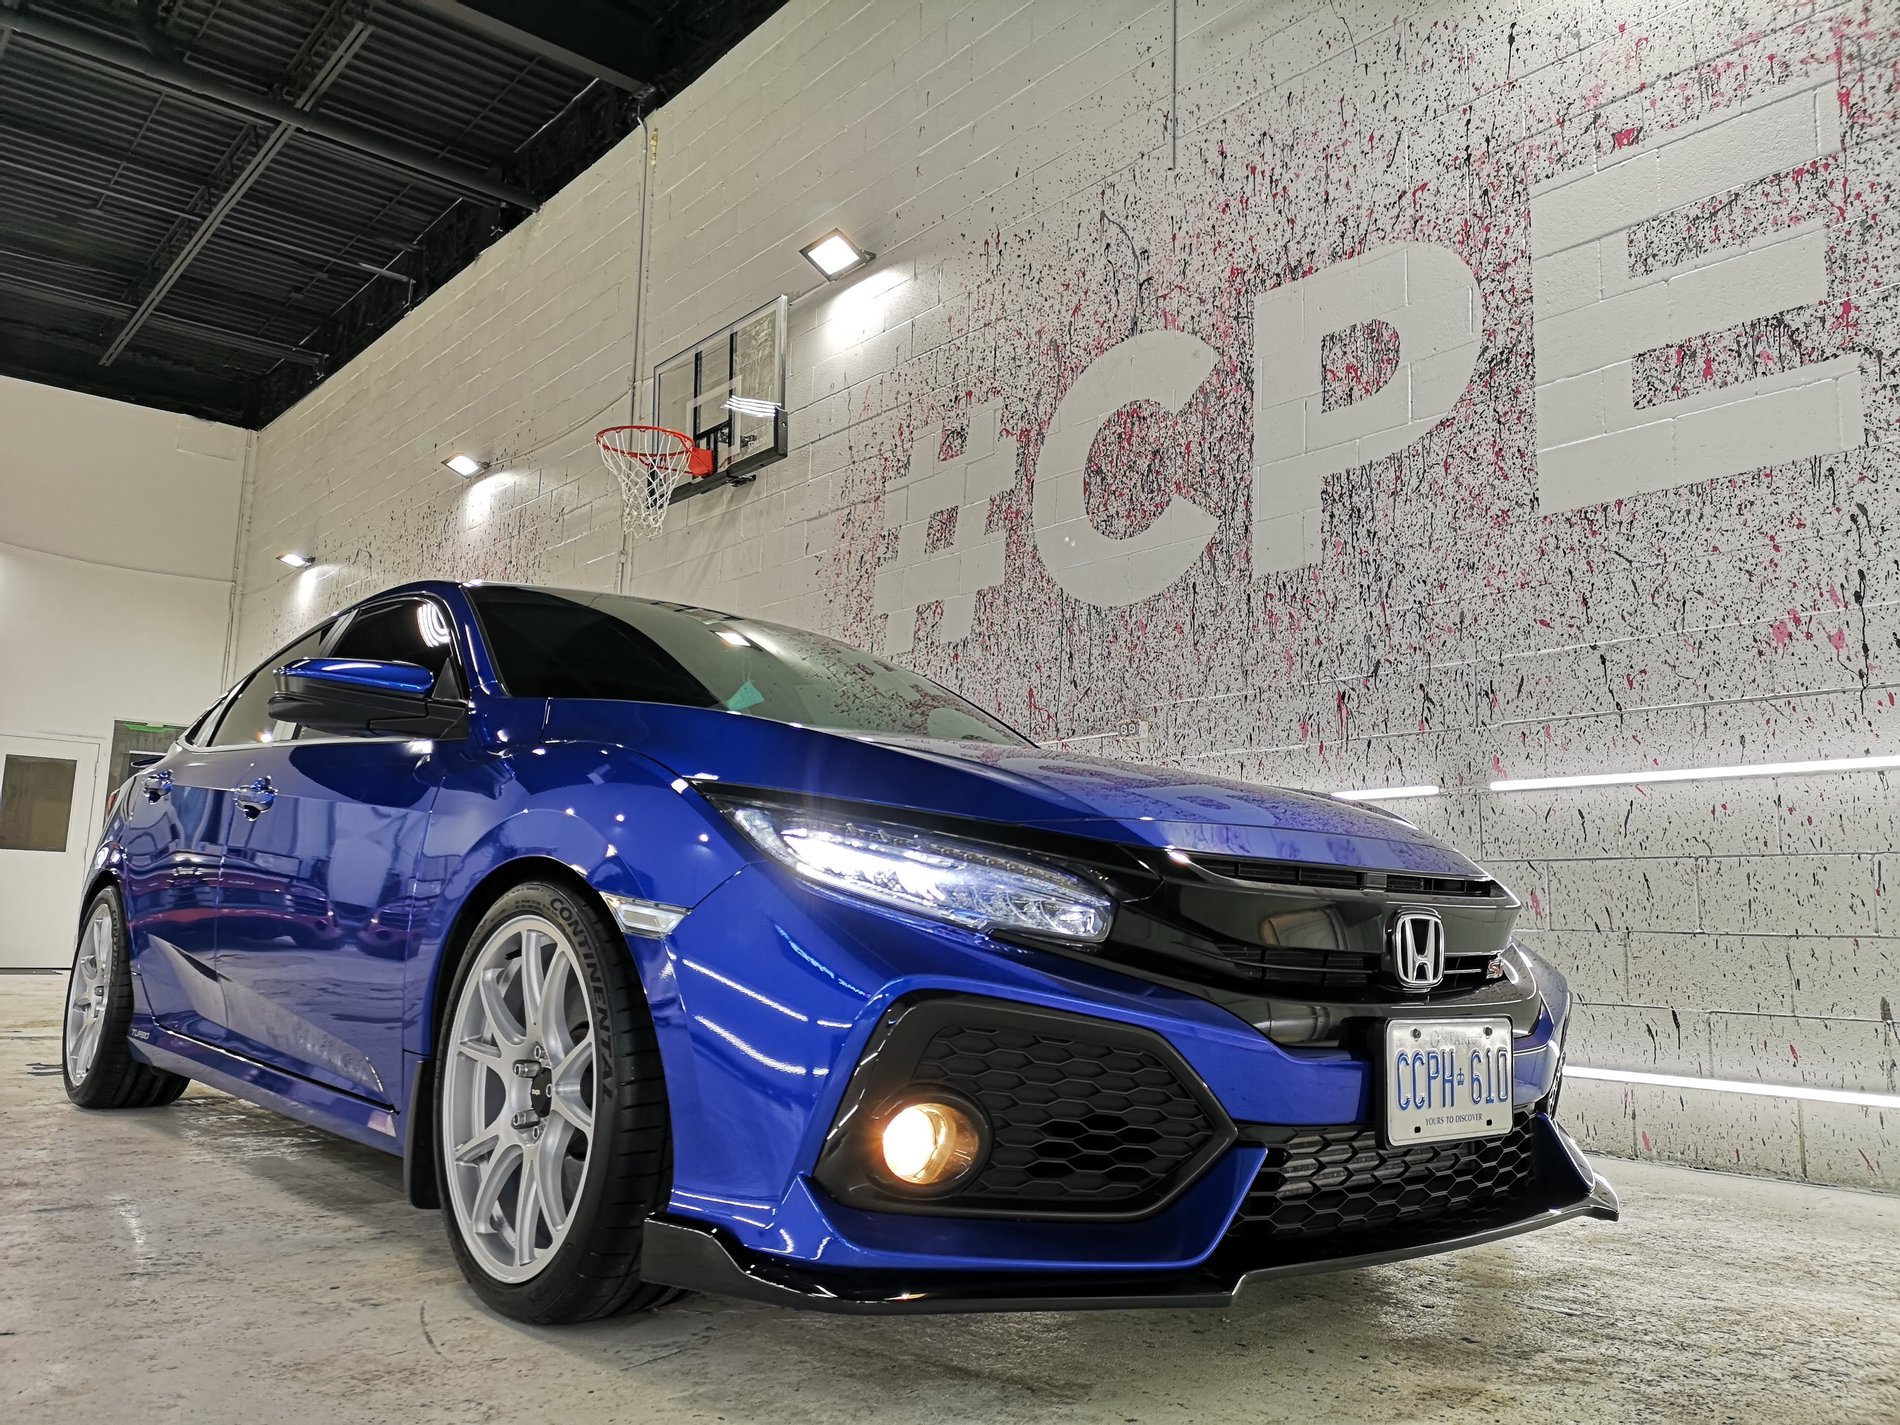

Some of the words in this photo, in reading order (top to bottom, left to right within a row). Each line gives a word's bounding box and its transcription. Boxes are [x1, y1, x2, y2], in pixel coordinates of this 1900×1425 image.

[872, 80, 1866, 655] #CPE
[550, 896, 616, 1100] CONTINENTAL
[1429, 1030, 1477, 1048] ONTAR
[1397, 1050, 1455, 1110] CCPH
[1470, 1048, 1508, 1104] 610
[1425, 1115, 1444, 1126] YOURS
[1446, 1114, 1454, 1124] TO
[1455, 1112, 1483, 1123] DISCOVER
